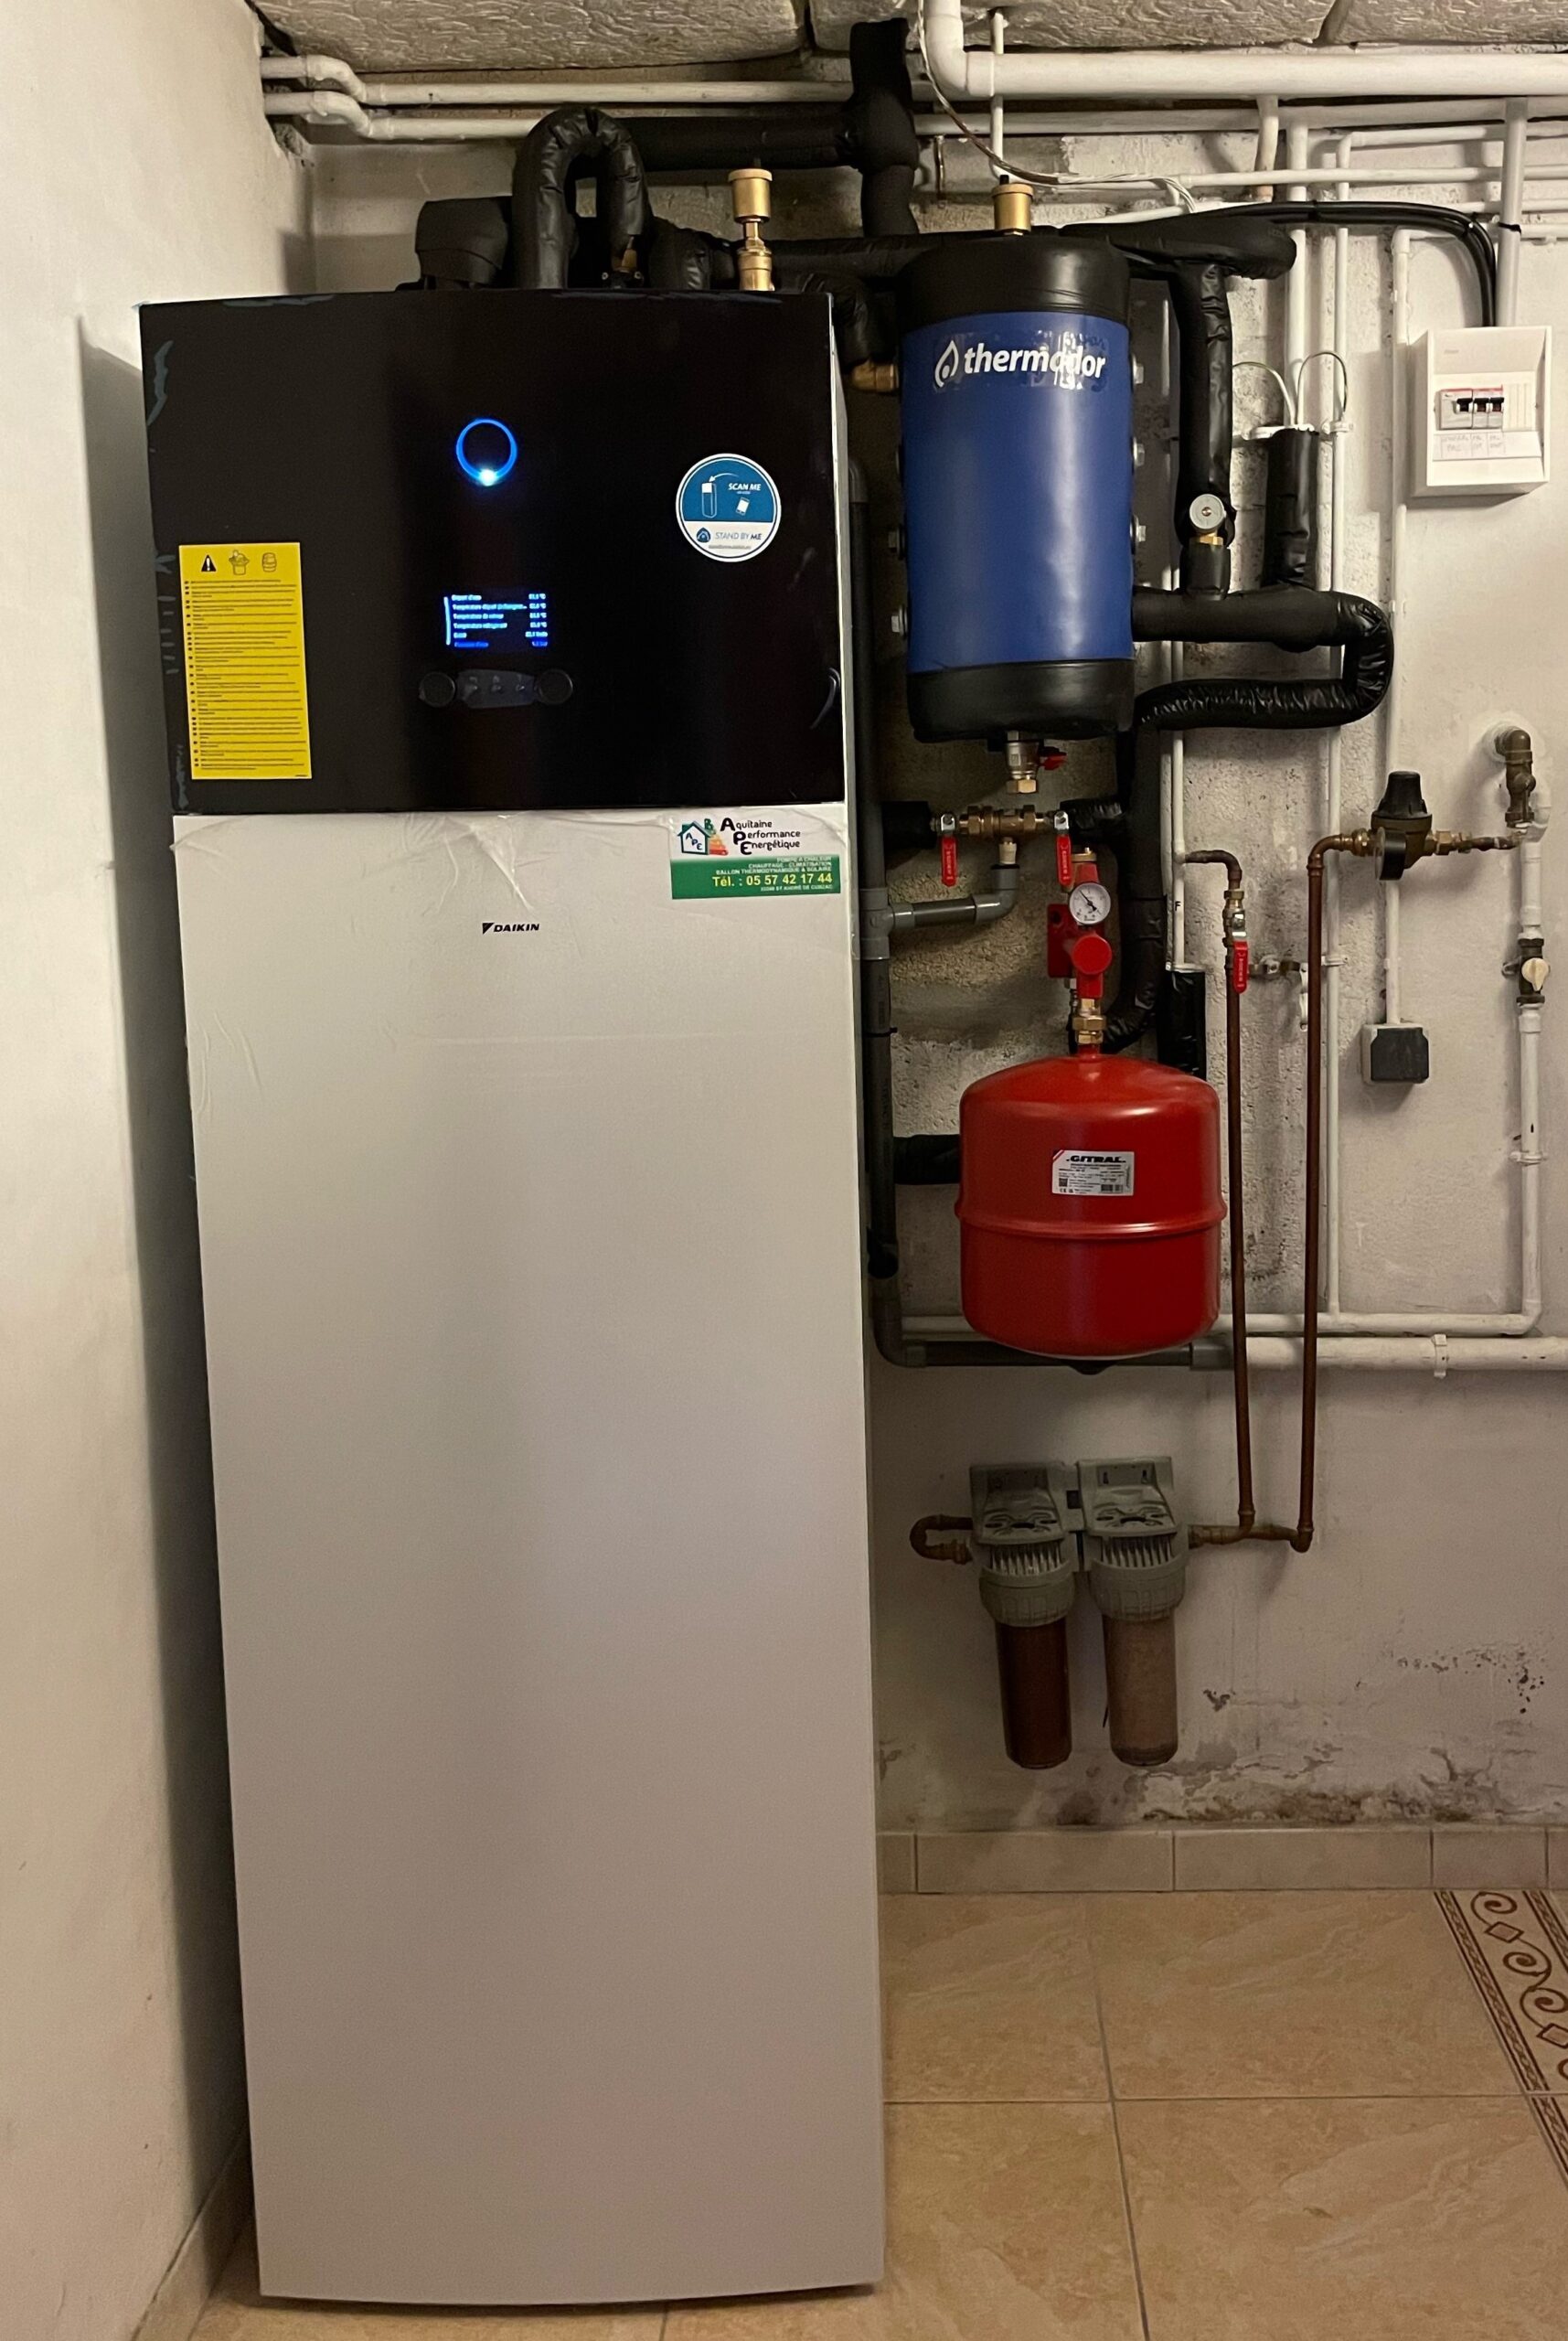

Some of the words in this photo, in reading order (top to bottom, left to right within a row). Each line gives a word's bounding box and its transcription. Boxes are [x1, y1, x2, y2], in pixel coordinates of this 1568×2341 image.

[728, 483, 748, 491] SCAN
[749, 483, 762, 491] ME
[720, 818, 773, 831] Aquitaine
[732, 830, 801, 845] Performance
[712, 875, 735, 887] Tél.
[746, 875, 761, 885] 05
[764, 874, 778, 885] 57
[782, 874, 796, 884] 42
[800, 873, 815, 883] 17
[817, 873, 833, 883] 44
[493, 924, 540, 933] DAIKIN
